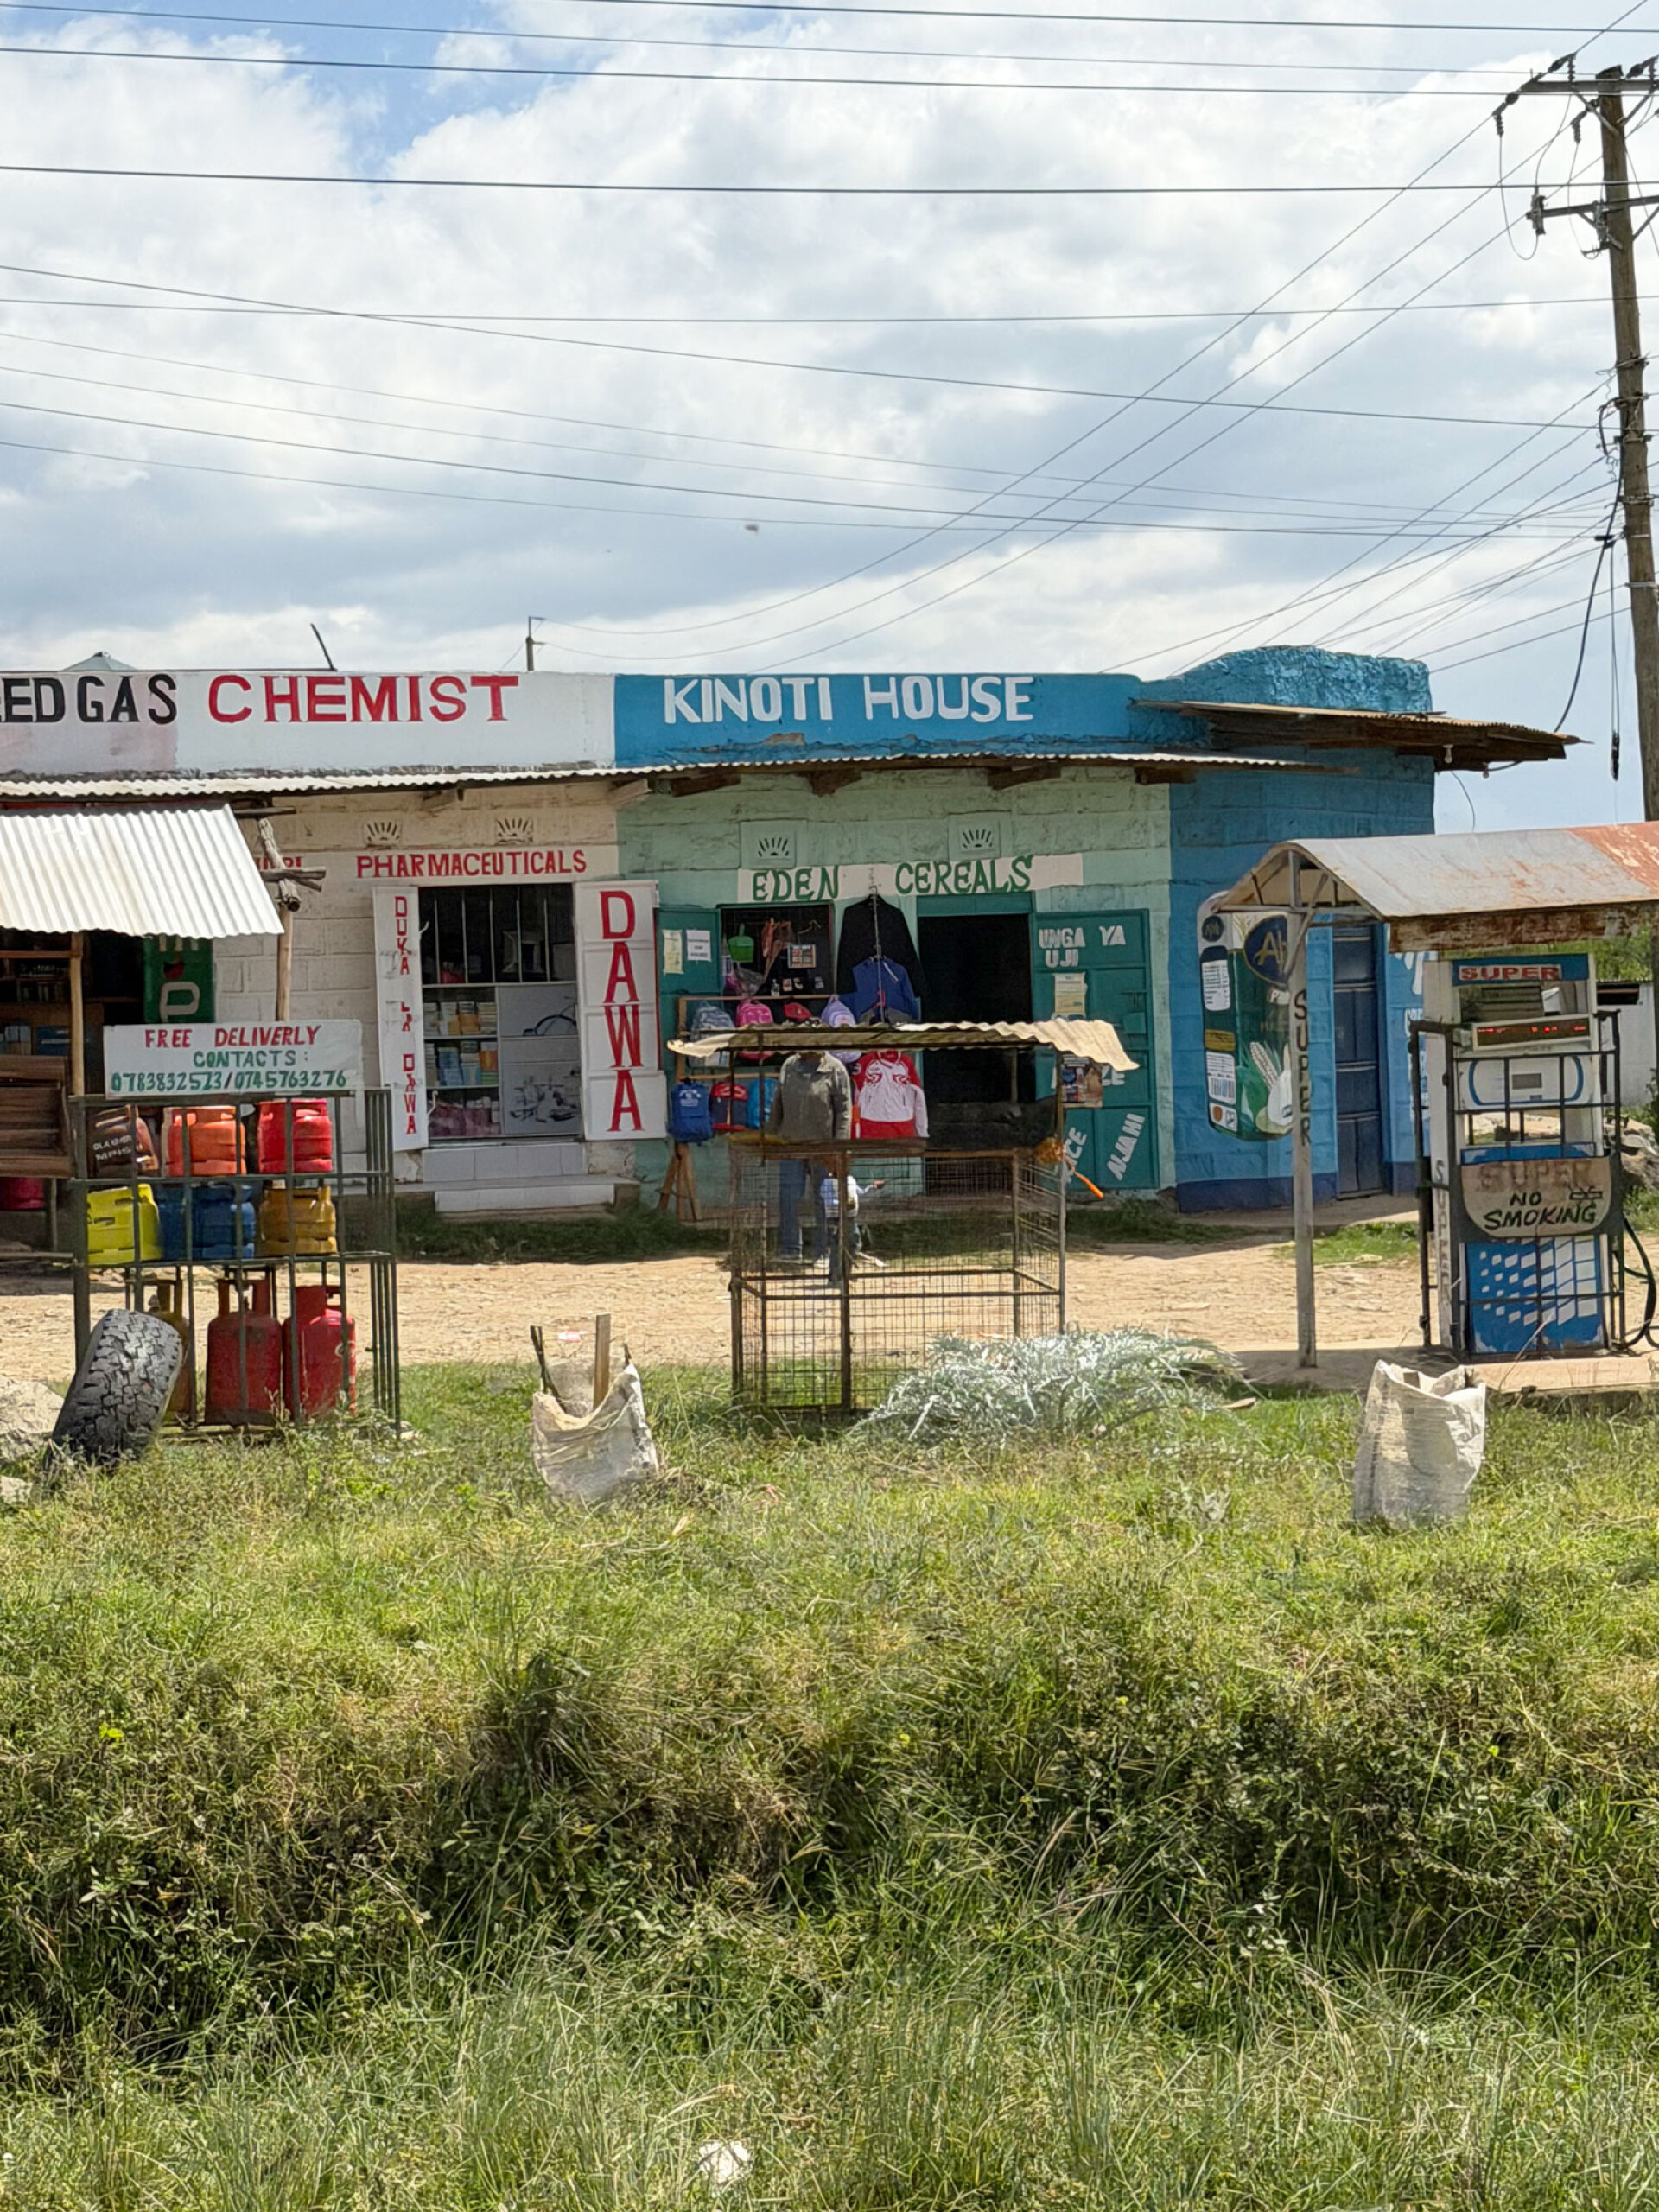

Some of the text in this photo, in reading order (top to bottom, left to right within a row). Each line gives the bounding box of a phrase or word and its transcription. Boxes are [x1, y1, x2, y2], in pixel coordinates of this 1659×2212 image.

[0, 674, 177, 725] ED GAS
[209, 675, 519, 723] CHEMIST
[664, 676, 1034, 724] KINOTI HOUSE
[356, 849, 588, 878] PHARMACEUTICALS
[753, 855, 1033, 902] EDEN CEREALS
[394, 896, 412, 975] DUKA
[1038, 925, 1127, 949] UNGA YA
[1045, 949, 1079, 968] UJI
[1461, 966, 1560, 981] SUPER
[144, 1026, 322, 1048] FREE DELIVERLY
[599, 890, 645, 1141] DAWA
[1294, 989, 1312, 1147] SUPER
[1107, 1113, 1146, 1182] NJAHI
[1483, 1201, 1598, 1231] SMOKING
[1509, 1191, 1542, 1206] NO
